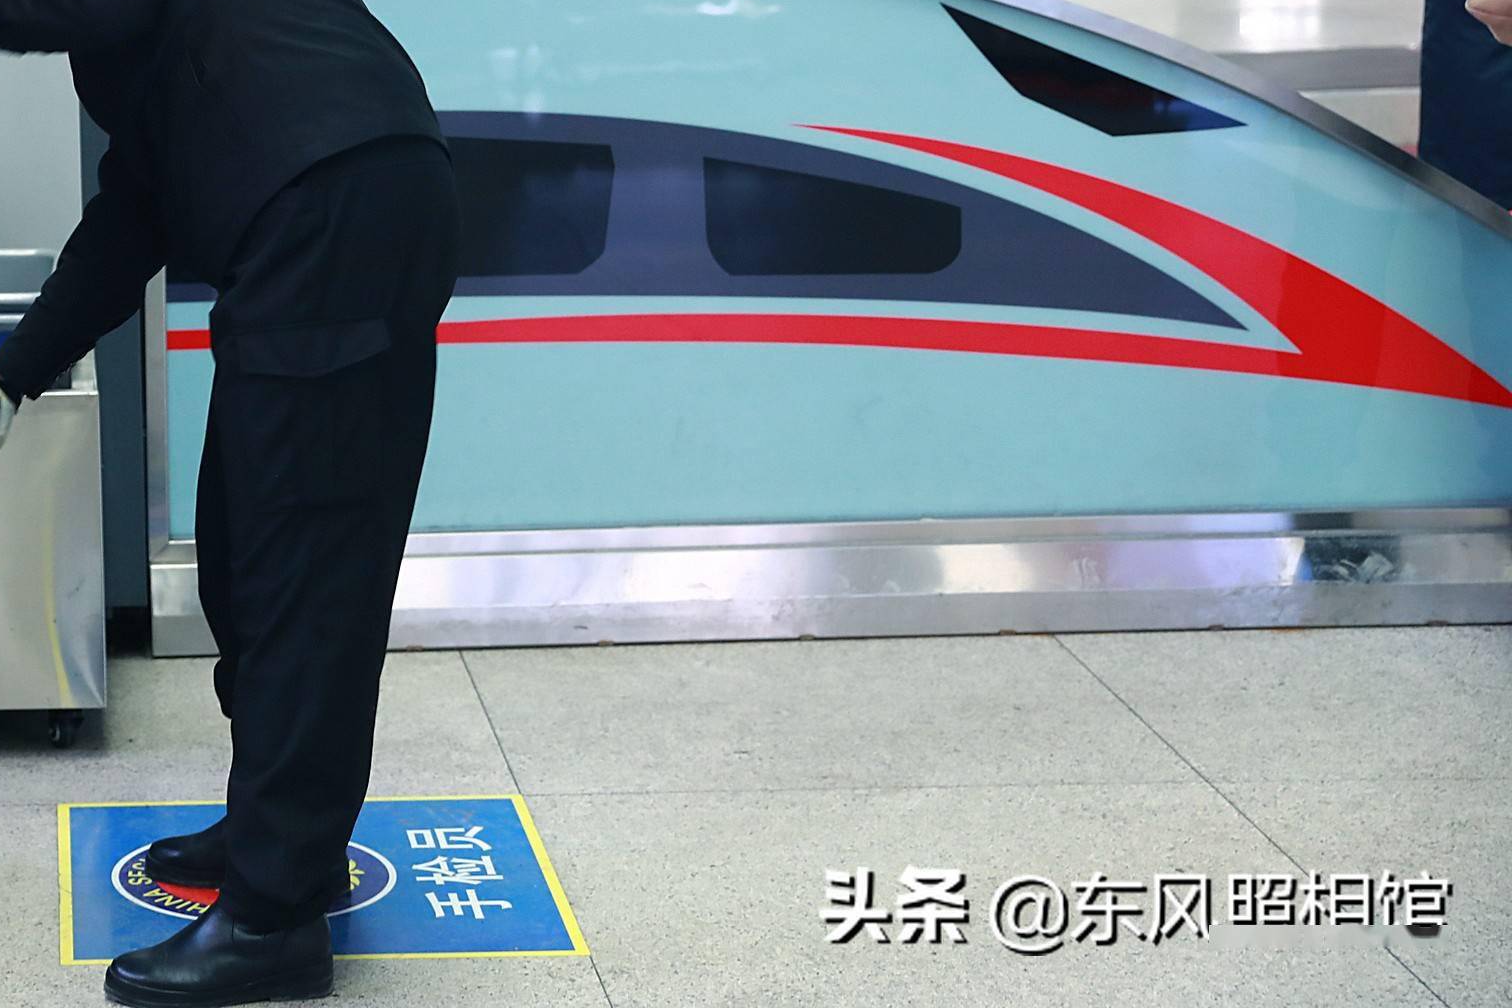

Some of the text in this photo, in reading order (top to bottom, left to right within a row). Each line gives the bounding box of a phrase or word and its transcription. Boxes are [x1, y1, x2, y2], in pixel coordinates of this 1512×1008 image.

[143, 888, 212, 914] HINA
[406, 825, 513, 920] 手检员
